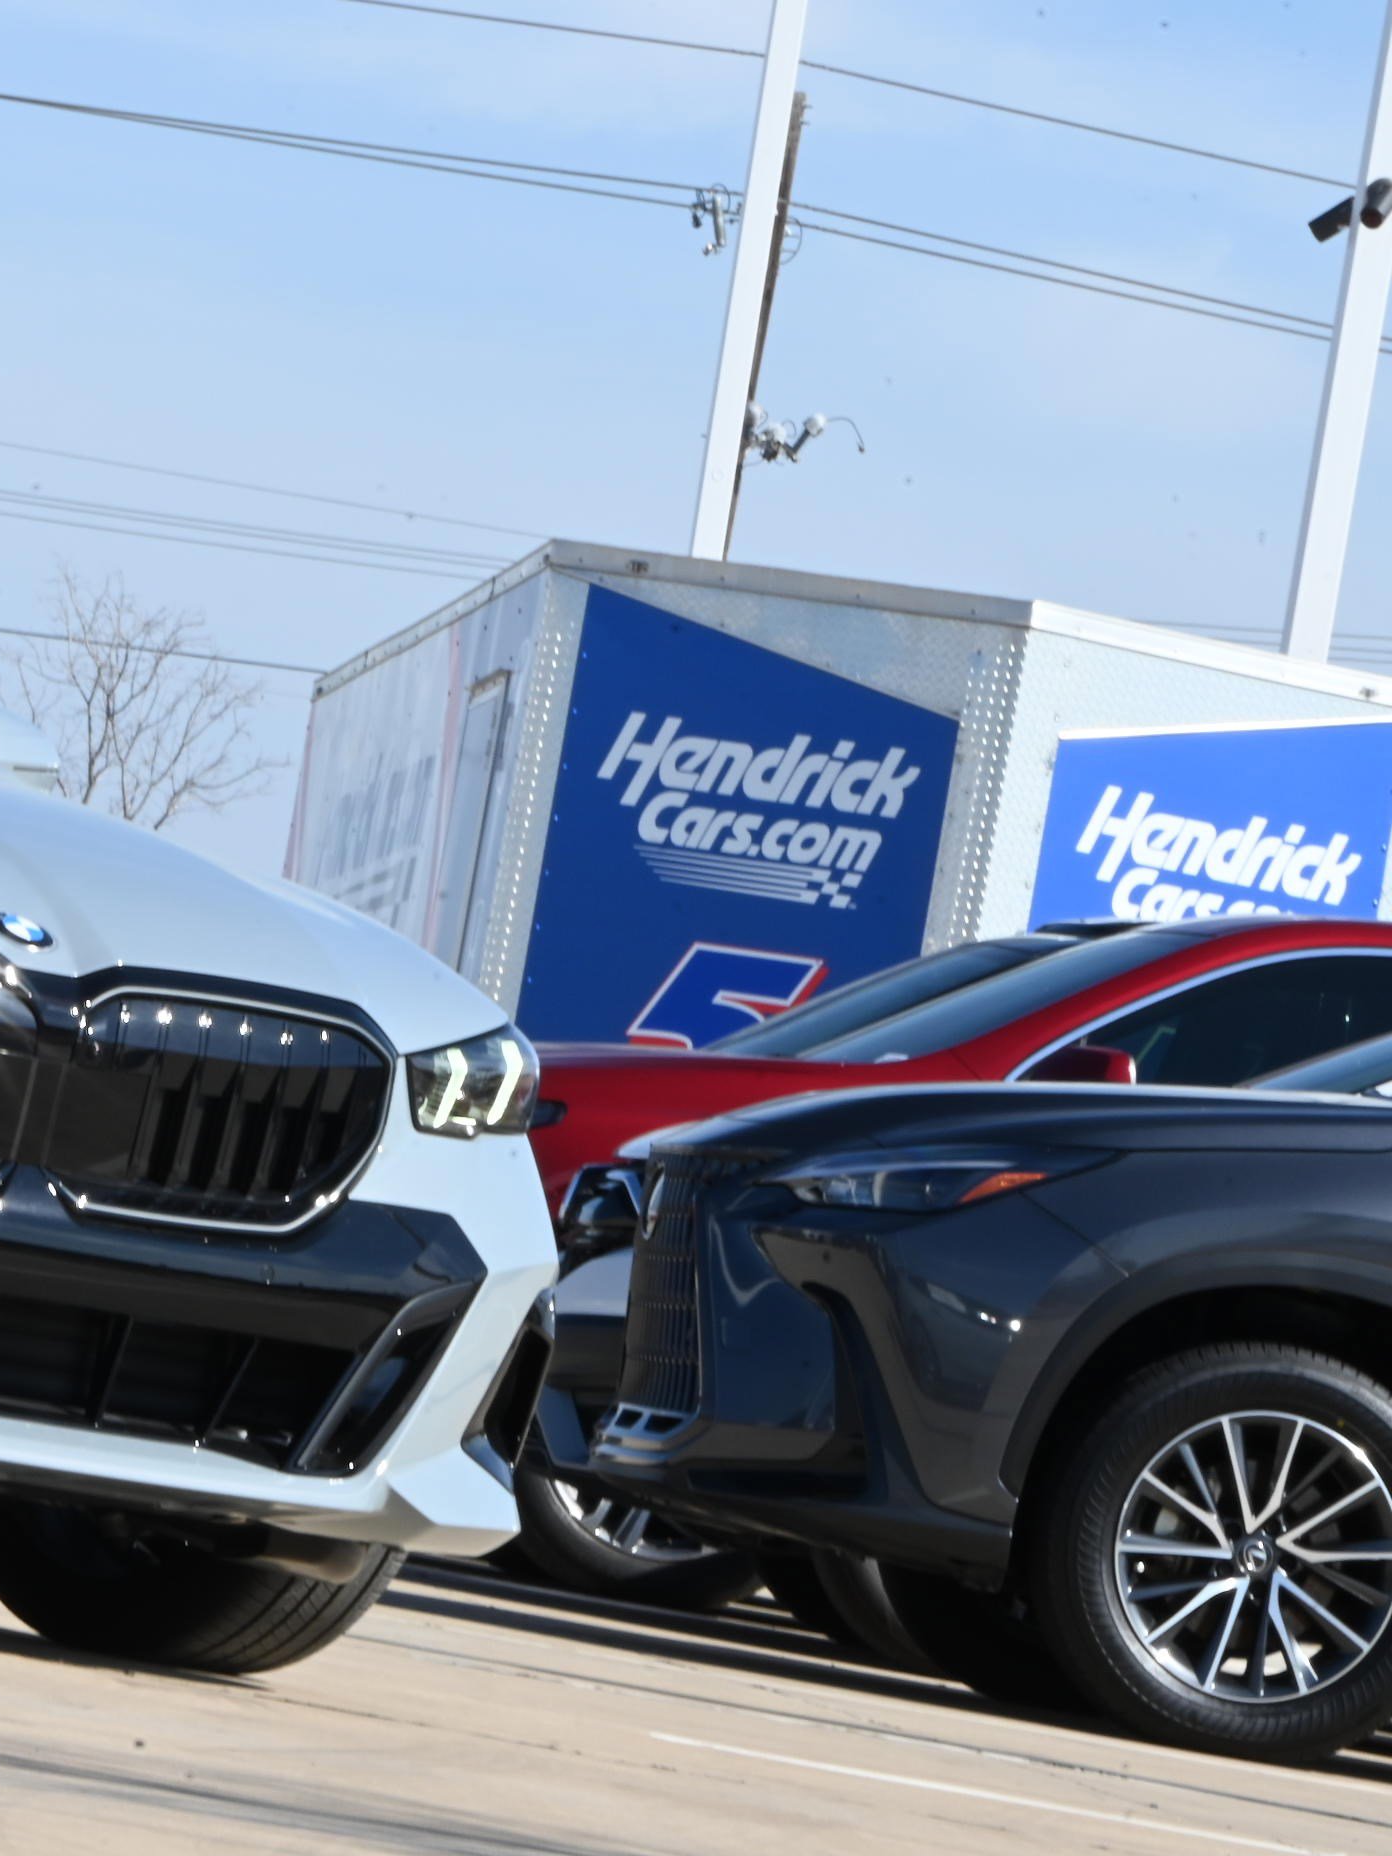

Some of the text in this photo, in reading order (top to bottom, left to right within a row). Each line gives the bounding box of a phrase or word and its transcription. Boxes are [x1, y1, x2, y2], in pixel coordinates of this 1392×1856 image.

[597, 711, 921, 819] Hendrick
[638, 790, 882, 873] Cars.com
[1076, 785, 1362, 906] Hendrick
